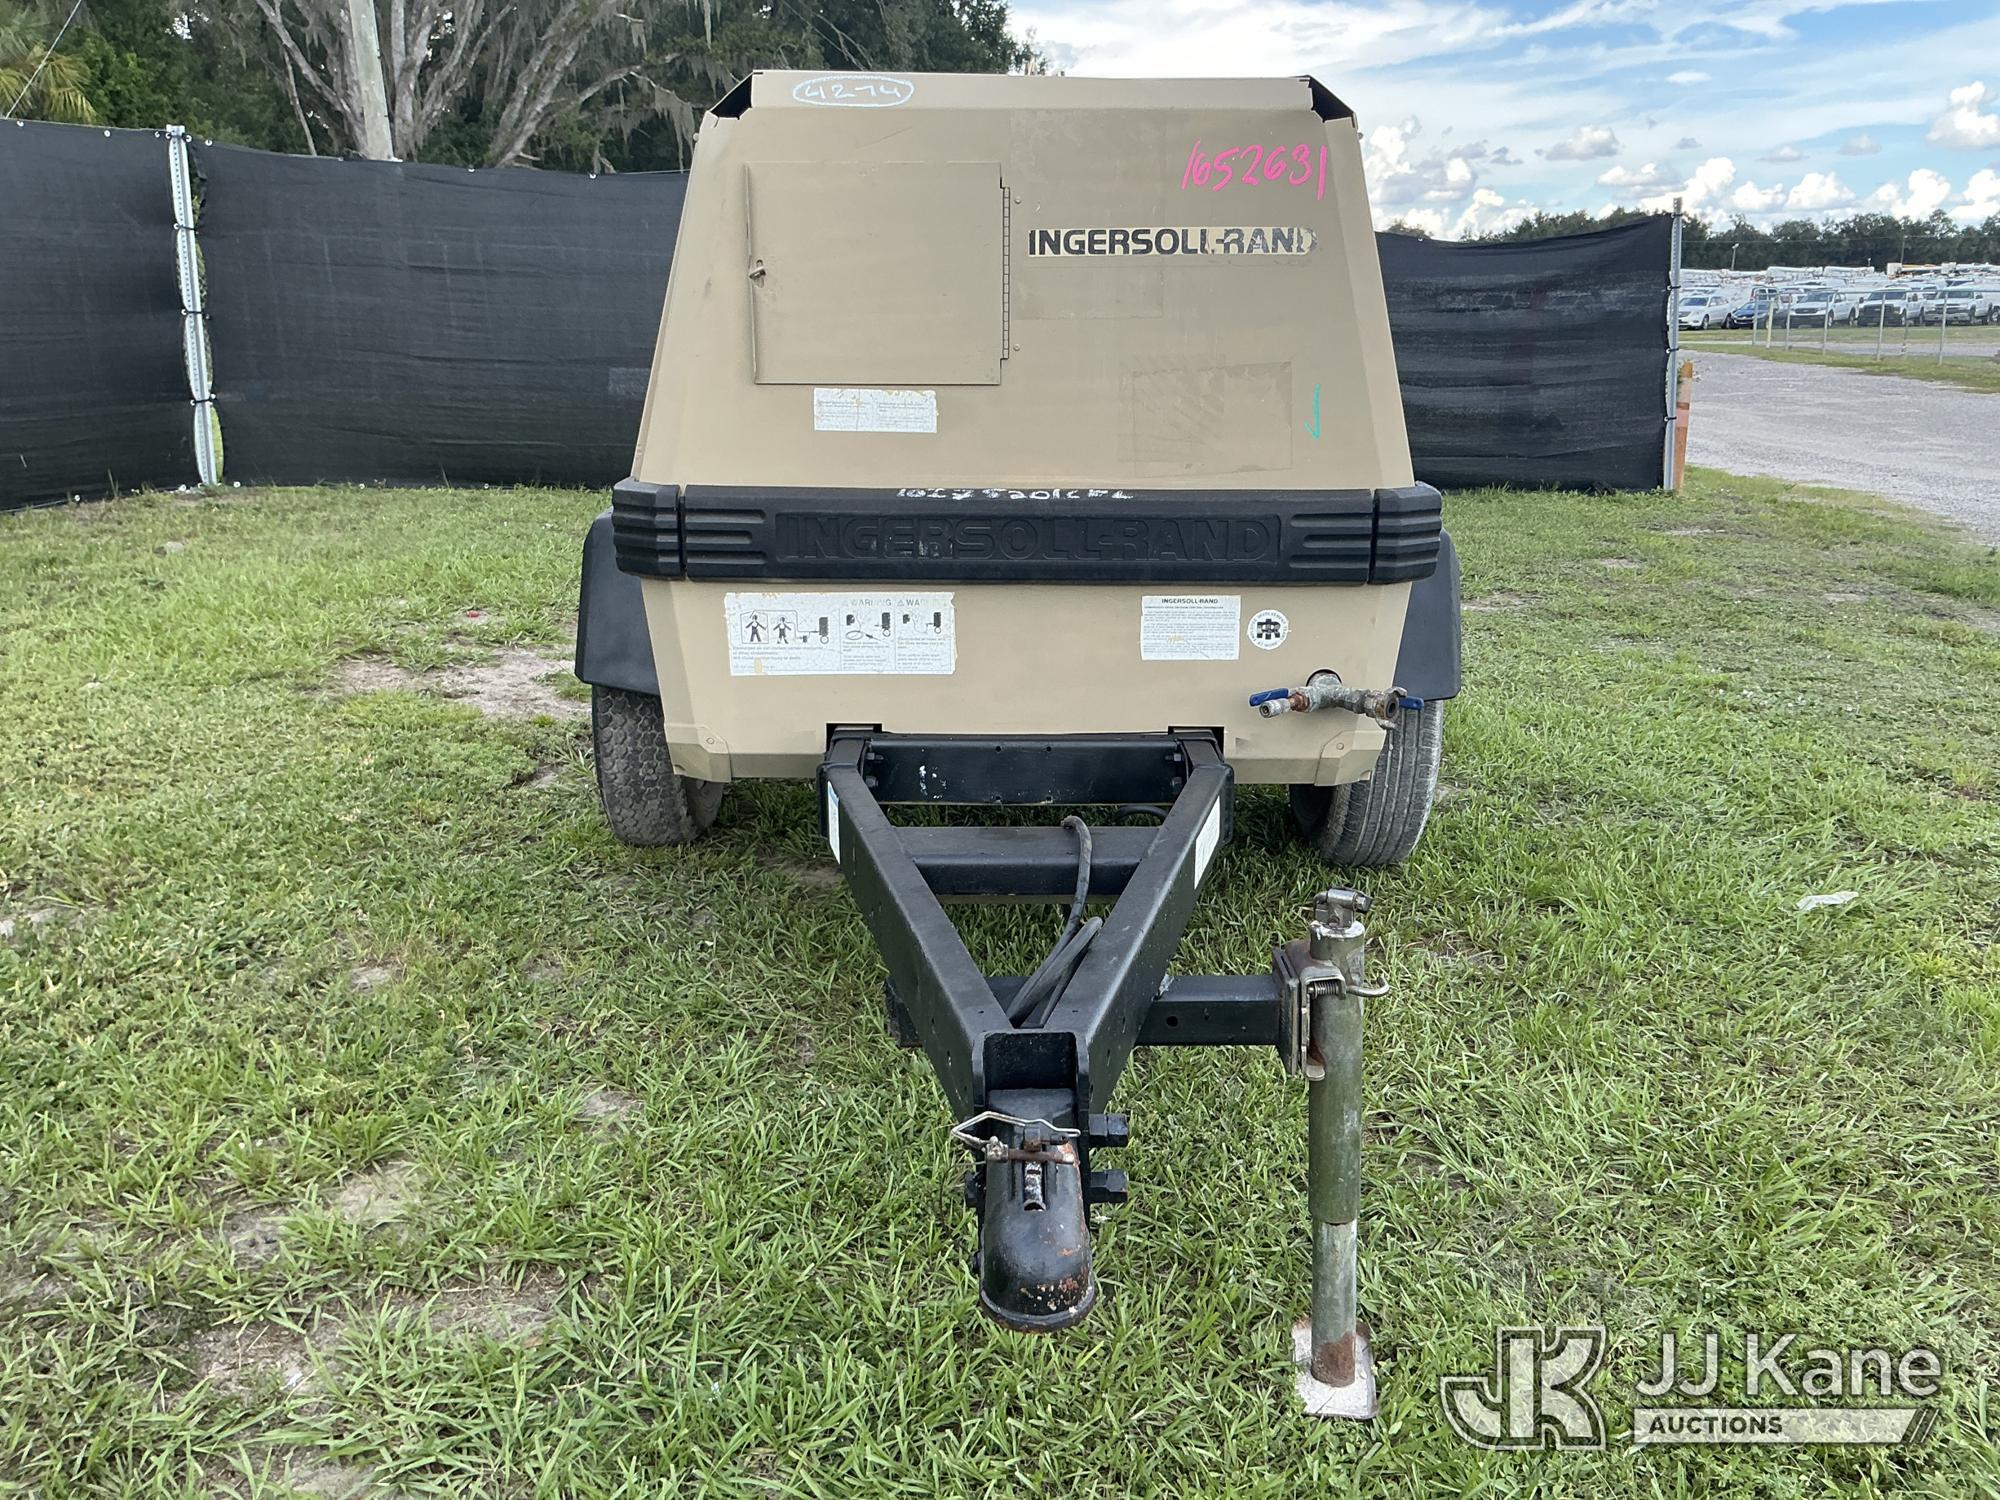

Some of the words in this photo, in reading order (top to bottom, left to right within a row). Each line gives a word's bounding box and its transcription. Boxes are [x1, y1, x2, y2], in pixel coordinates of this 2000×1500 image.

[804, 84, 902, 99] 4274
[1180, 139, 1328, 201] 1652631
[786, 516, 1270, 561] INGERSOLL-RAND
